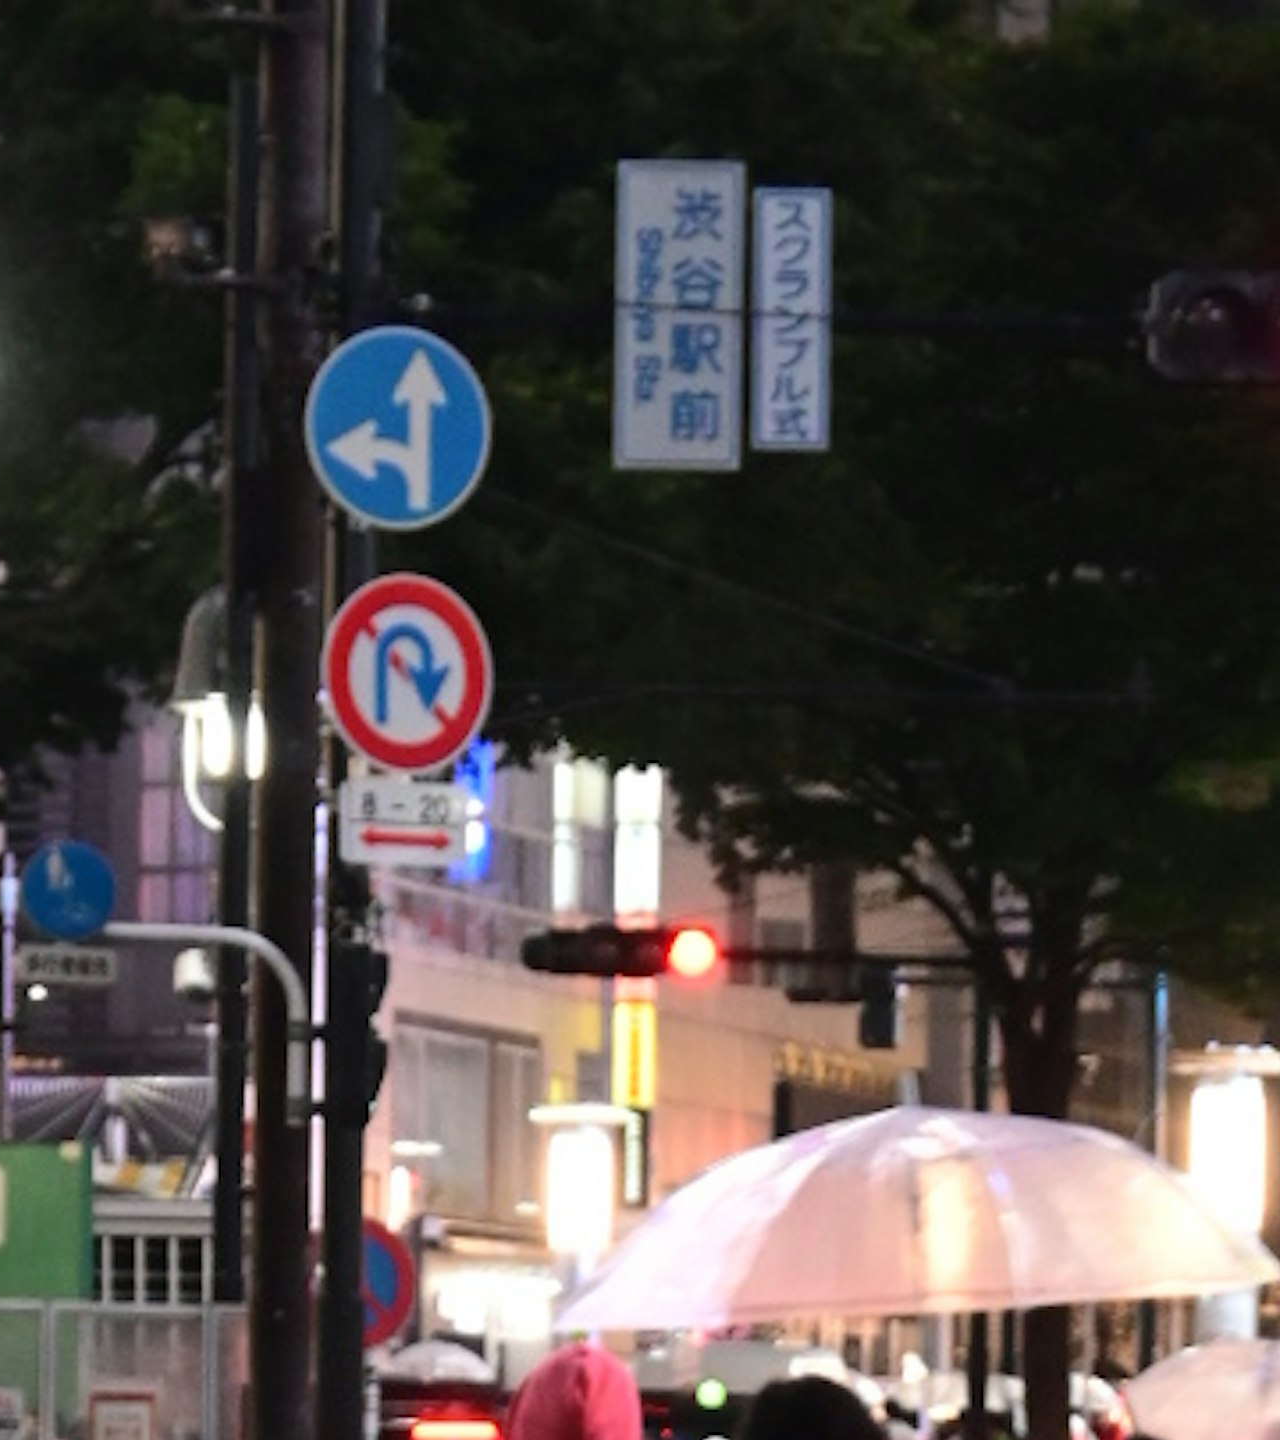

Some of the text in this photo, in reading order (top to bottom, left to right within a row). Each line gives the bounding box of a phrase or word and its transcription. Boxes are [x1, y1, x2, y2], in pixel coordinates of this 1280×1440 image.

[633, 226, 663, 342] Shibuya
[671, 186, 723, 441] 渋谷駅前
[362, 790, 377, 817] 8
[419, 793, 450, 824] 20
